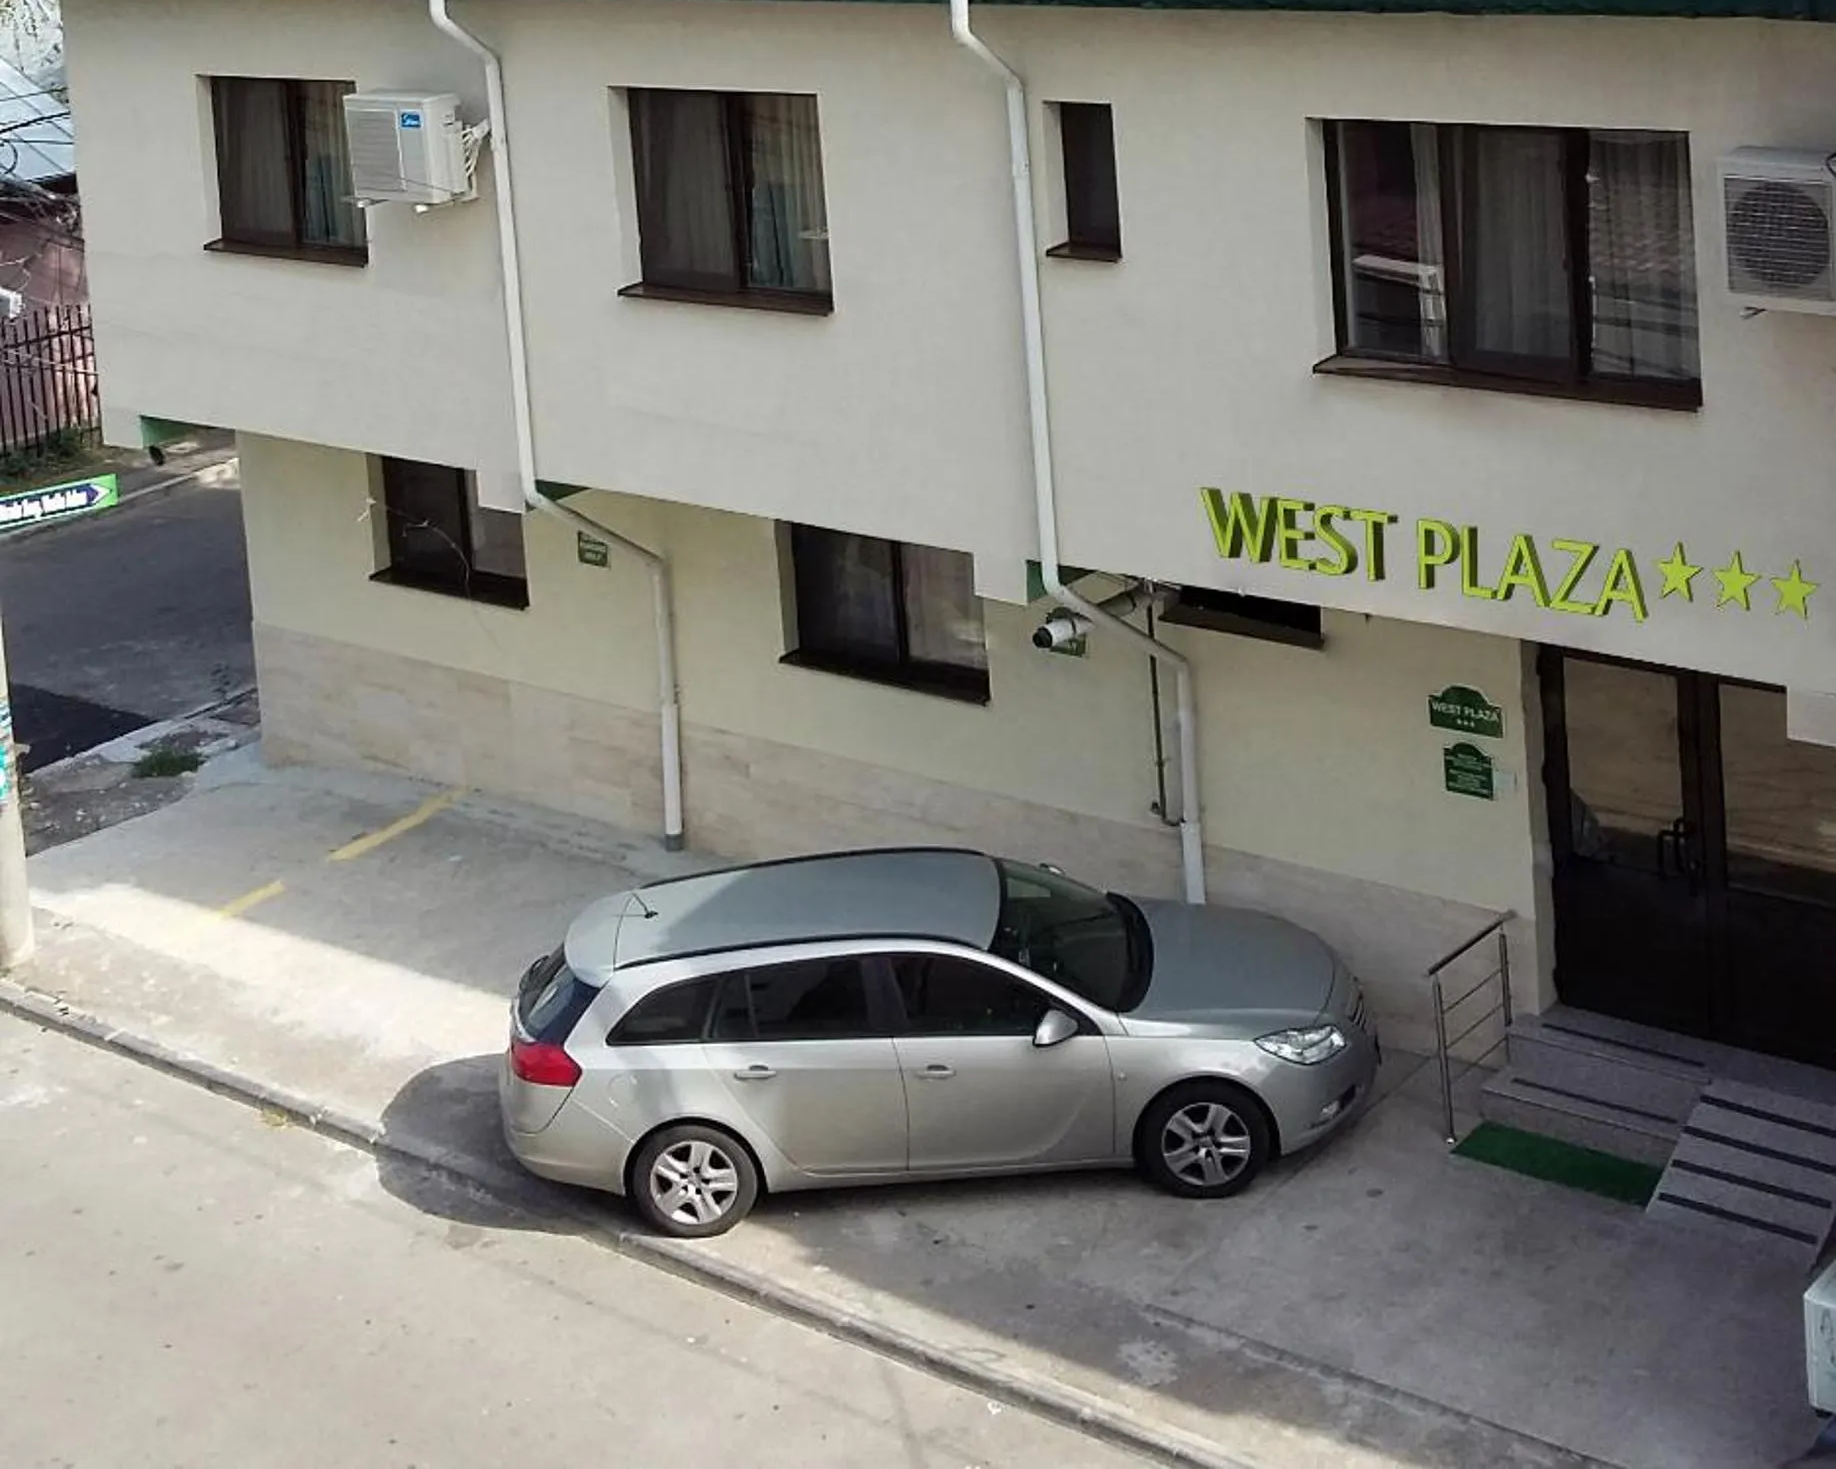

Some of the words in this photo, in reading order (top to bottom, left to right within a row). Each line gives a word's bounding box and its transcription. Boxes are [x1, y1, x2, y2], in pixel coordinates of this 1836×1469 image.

[1200, 487, 1398, 582] WEST
[1416, 518, 1649, 622] PLAZA
[1432, 701, 1461, 715] WEST
[1463, 705, 1499, 723] PLAZA
